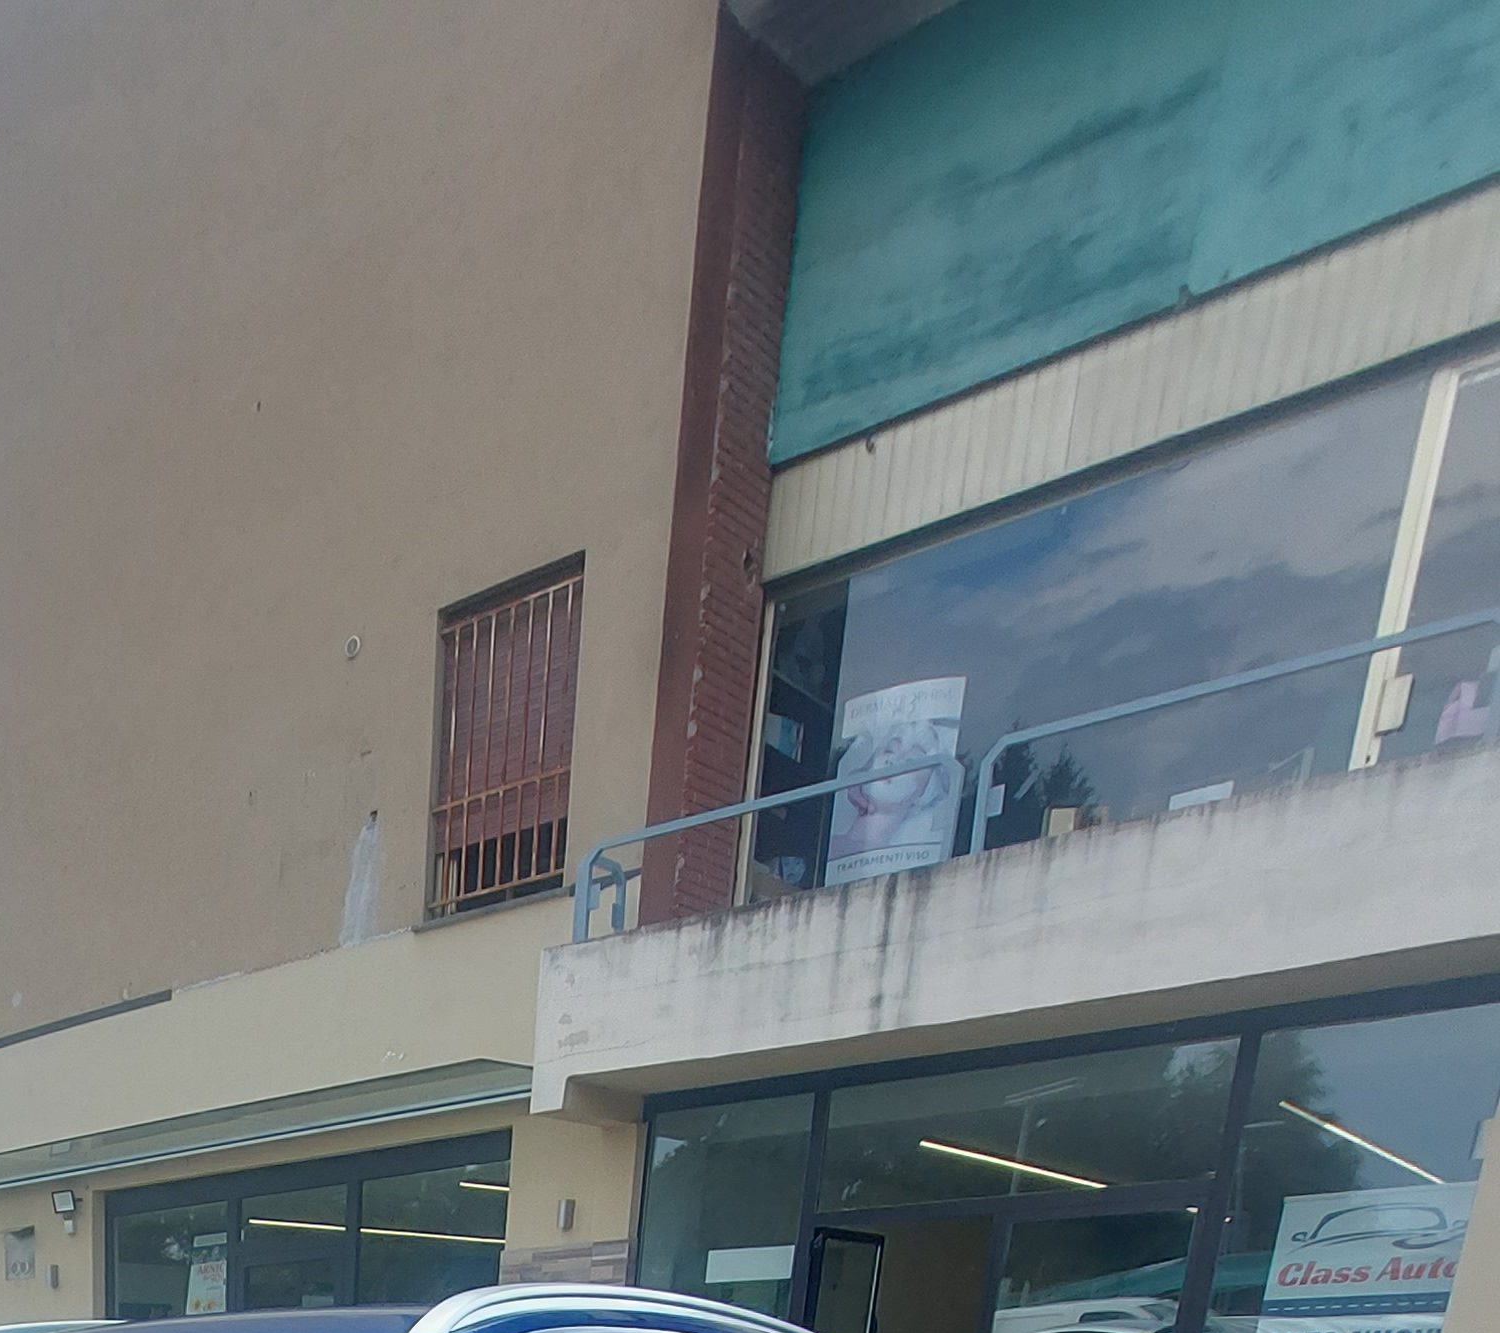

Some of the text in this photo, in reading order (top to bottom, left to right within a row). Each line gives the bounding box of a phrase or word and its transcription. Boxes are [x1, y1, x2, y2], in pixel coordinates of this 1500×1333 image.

[837, 850, 930, 872] TRATTAMENTI VISO
[1277, 1261, 1372, 1287] Class
